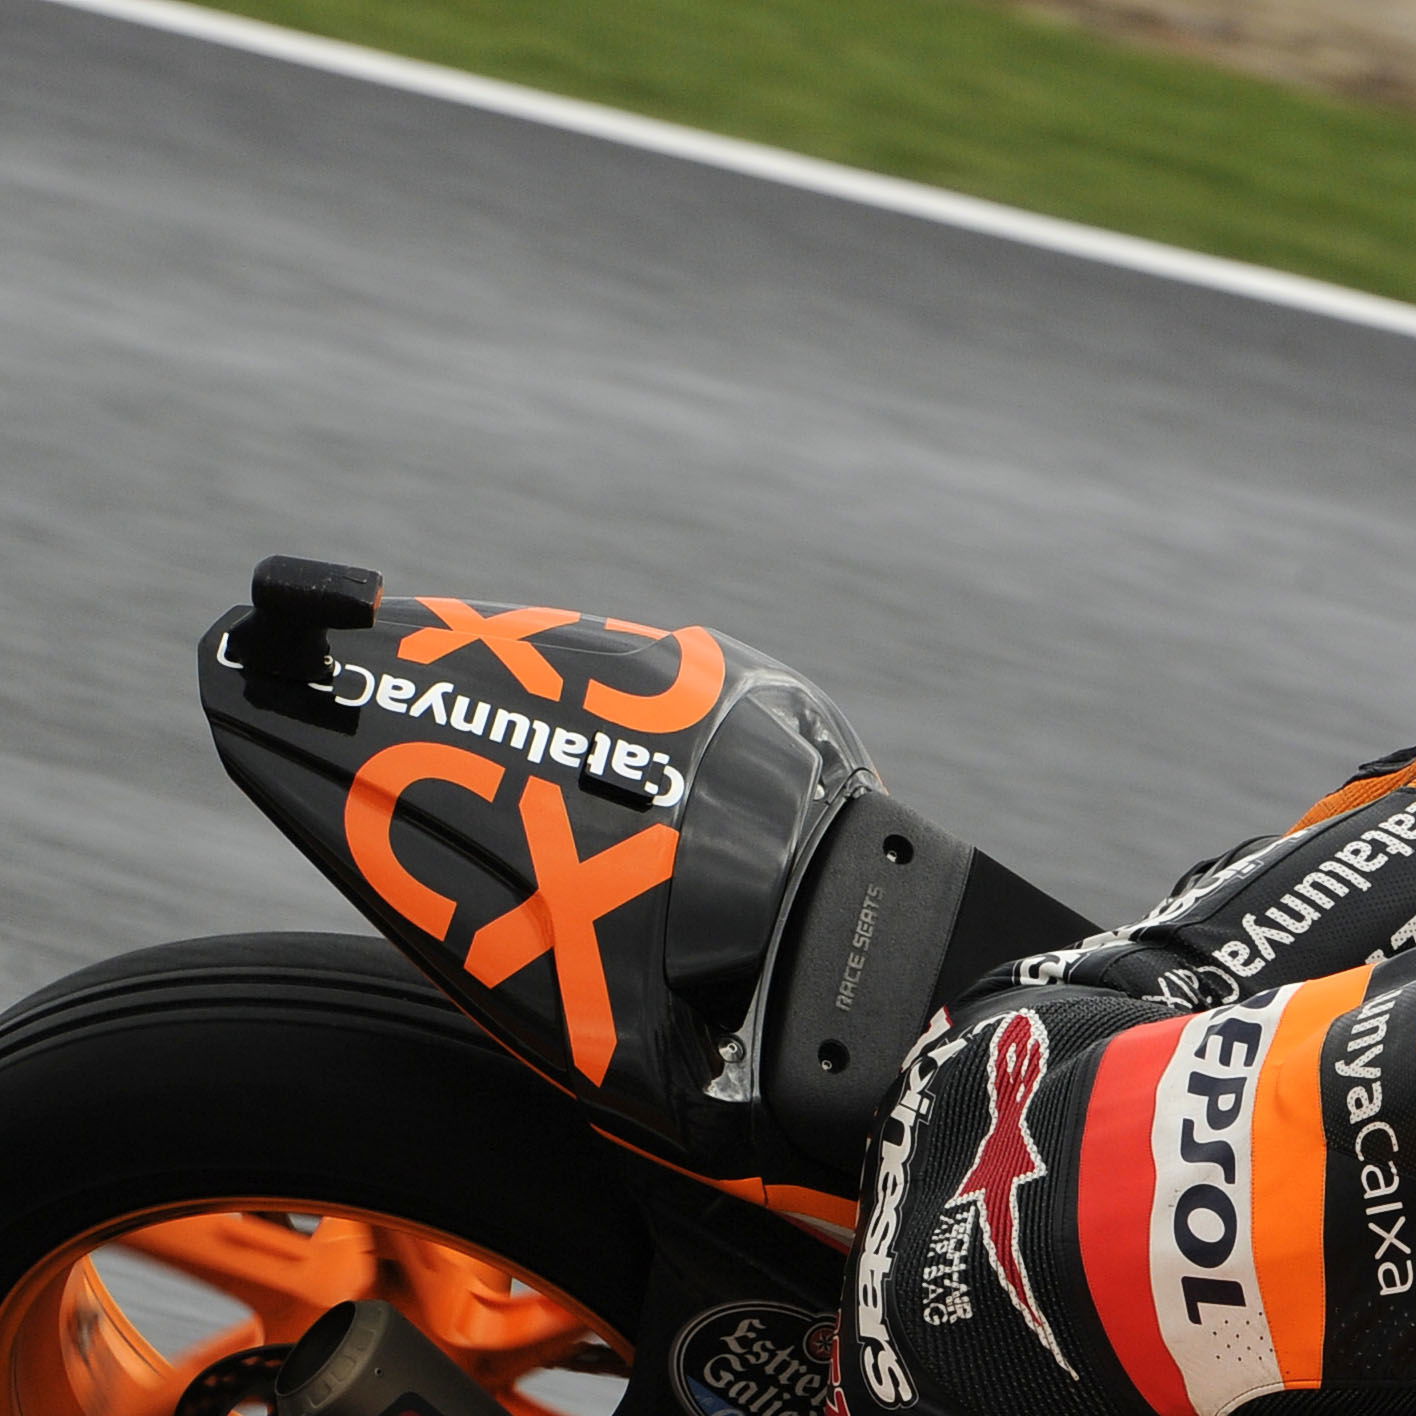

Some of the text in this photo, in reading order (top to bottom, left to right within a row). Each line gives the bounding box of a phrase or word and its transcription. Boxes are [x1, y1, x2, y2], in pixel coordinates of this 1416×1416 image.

[344, 741, 681, 1088] CX
[835, 883, 886, 1012] RACE SEATS
